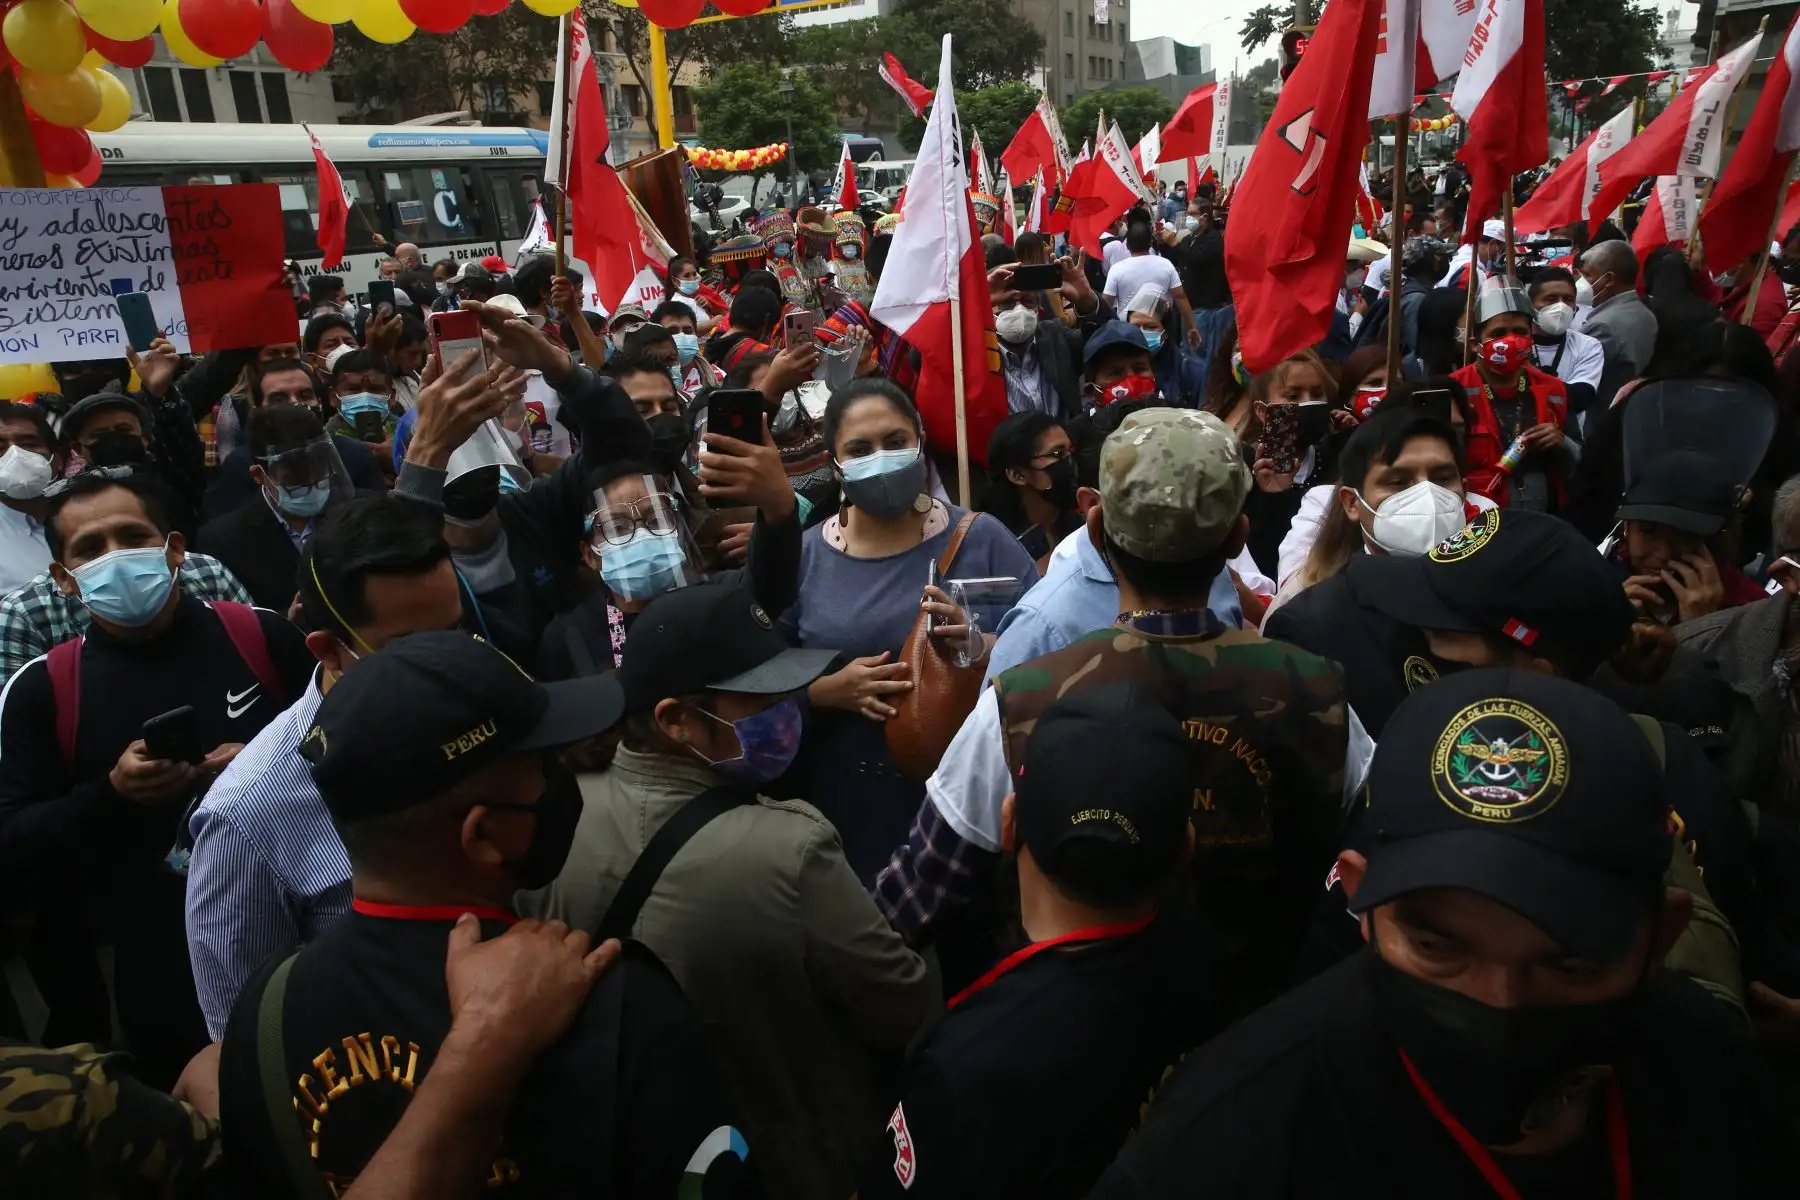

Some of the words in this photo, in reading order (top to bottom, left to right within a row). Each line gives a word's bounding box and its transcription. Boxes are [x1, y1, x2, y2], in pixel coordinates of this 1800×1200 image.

[39, 194, 232, 237] adolescentes
[457, 249, 469, 260] DE
[471, 246, 495, 258] MAYO
[140, 265, 165, 292] de
[0, 298, 122, 332] Sistem
[57, 328, 119, 346] PARA
[440, 717, 498, 761] PERU
[1182, 720, 1228, 745] TIVO
[1435, 717, 1465, 774] LICENCIADOS
[1467, 707, 1481, 719] DE
[1483, 703, 1506, 713] LAS
[1509, 703, 1552, 737] FUERZAS
[1548, 737, 1567, 785] ARMADAS
[1071, 808, 1110, 824] EJERCITO
[1471, 804, 1512, 818] PERU
